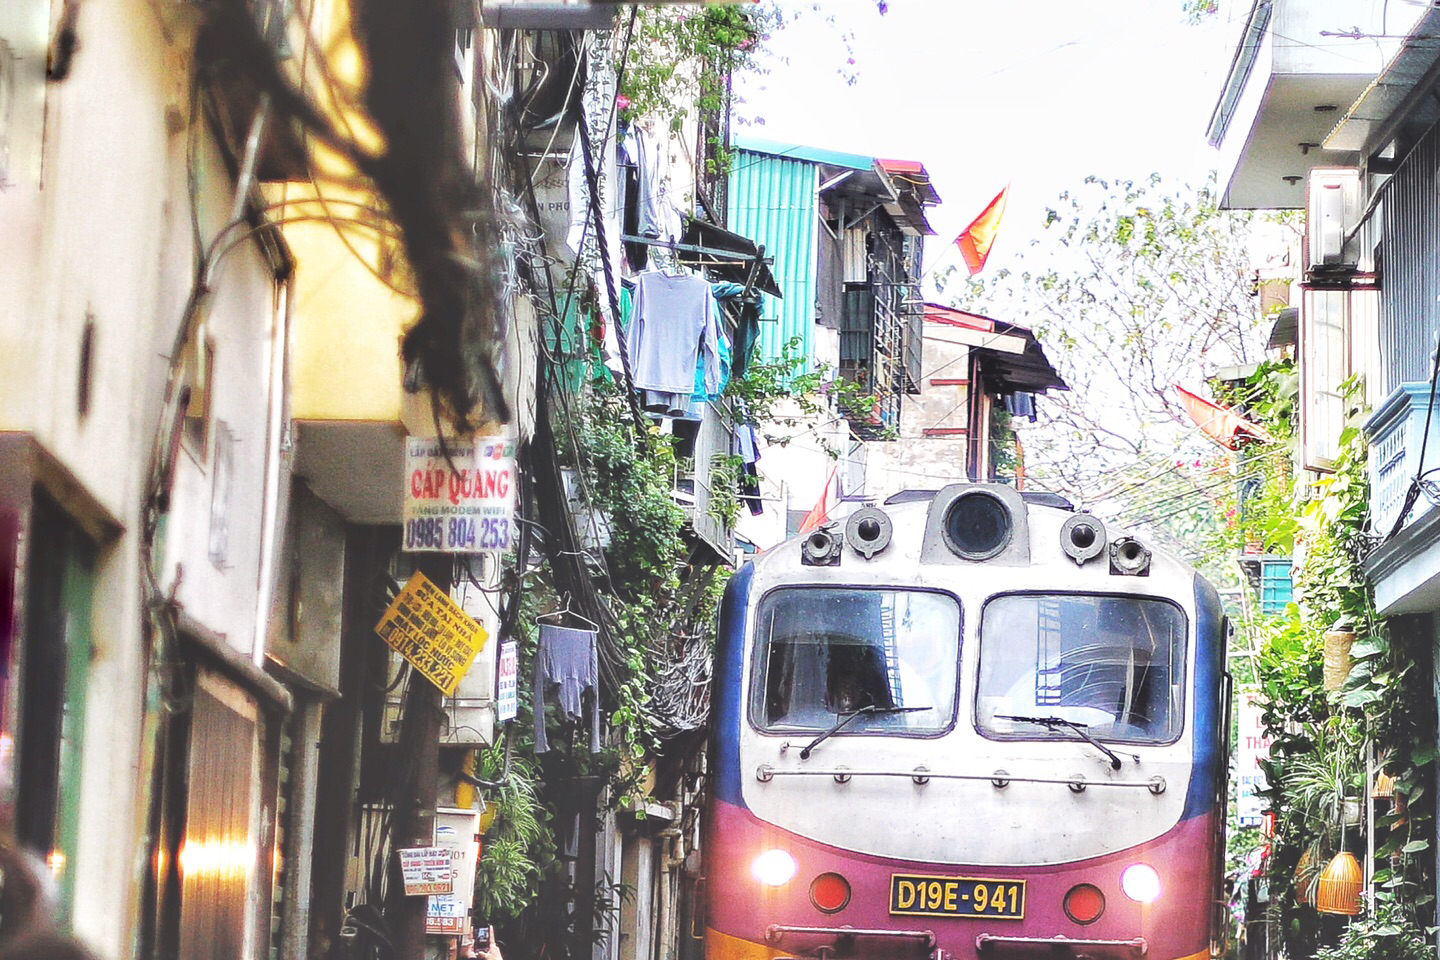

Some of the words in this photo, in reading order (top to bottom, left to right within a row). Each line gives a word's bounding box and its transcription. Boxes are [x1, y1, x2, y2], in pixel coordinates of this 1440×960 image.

[449, 468, 509, 505] QUANG
[406, 517, 444, 549] 0985
[448, 517, 475, 548] 804
[481, 517, 509, 549] 253
[897, 880, 1018, 913] D19E-941
